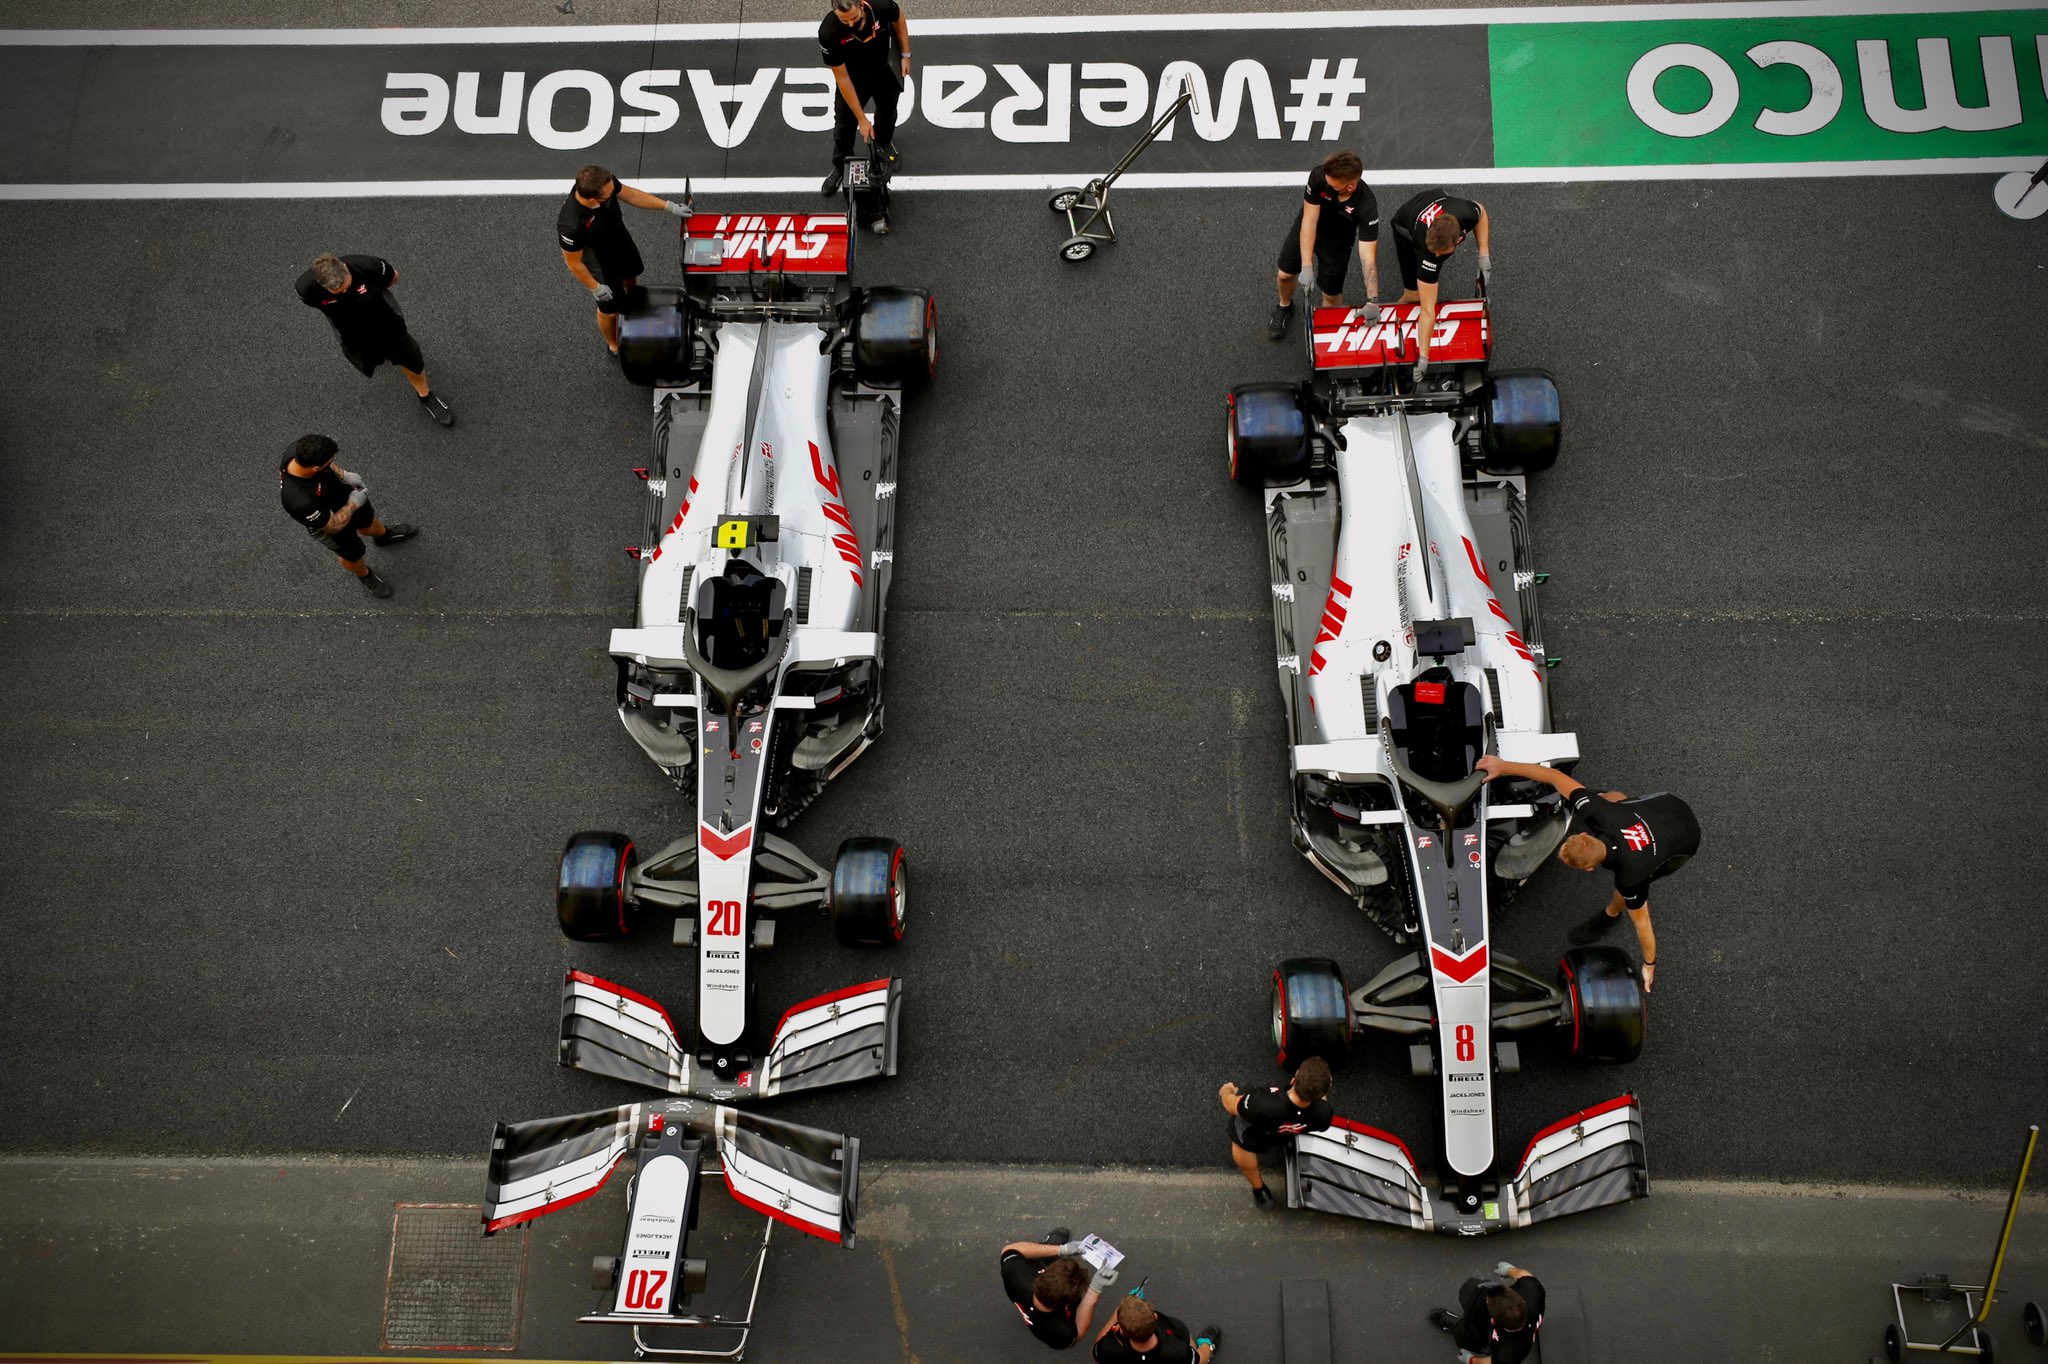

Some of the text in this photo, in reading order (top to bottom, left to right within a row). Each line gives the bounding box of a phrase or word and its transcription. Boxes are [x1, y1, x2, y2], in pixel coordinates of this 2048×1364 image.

[1625, 34, 2048, 138] mco
[713, 216, 847, 259] HAAS
[707, 900, 741, 936] 20
[706, 950, 740, 959] PIRELLI
[1455, 1024, 1475, 1062] 8
[1448, 1073, 1484, 1082] PIRELLI
[632, 1249, 670, 1259] PIRELLI
[625, 1269, 668, 1310] 20
